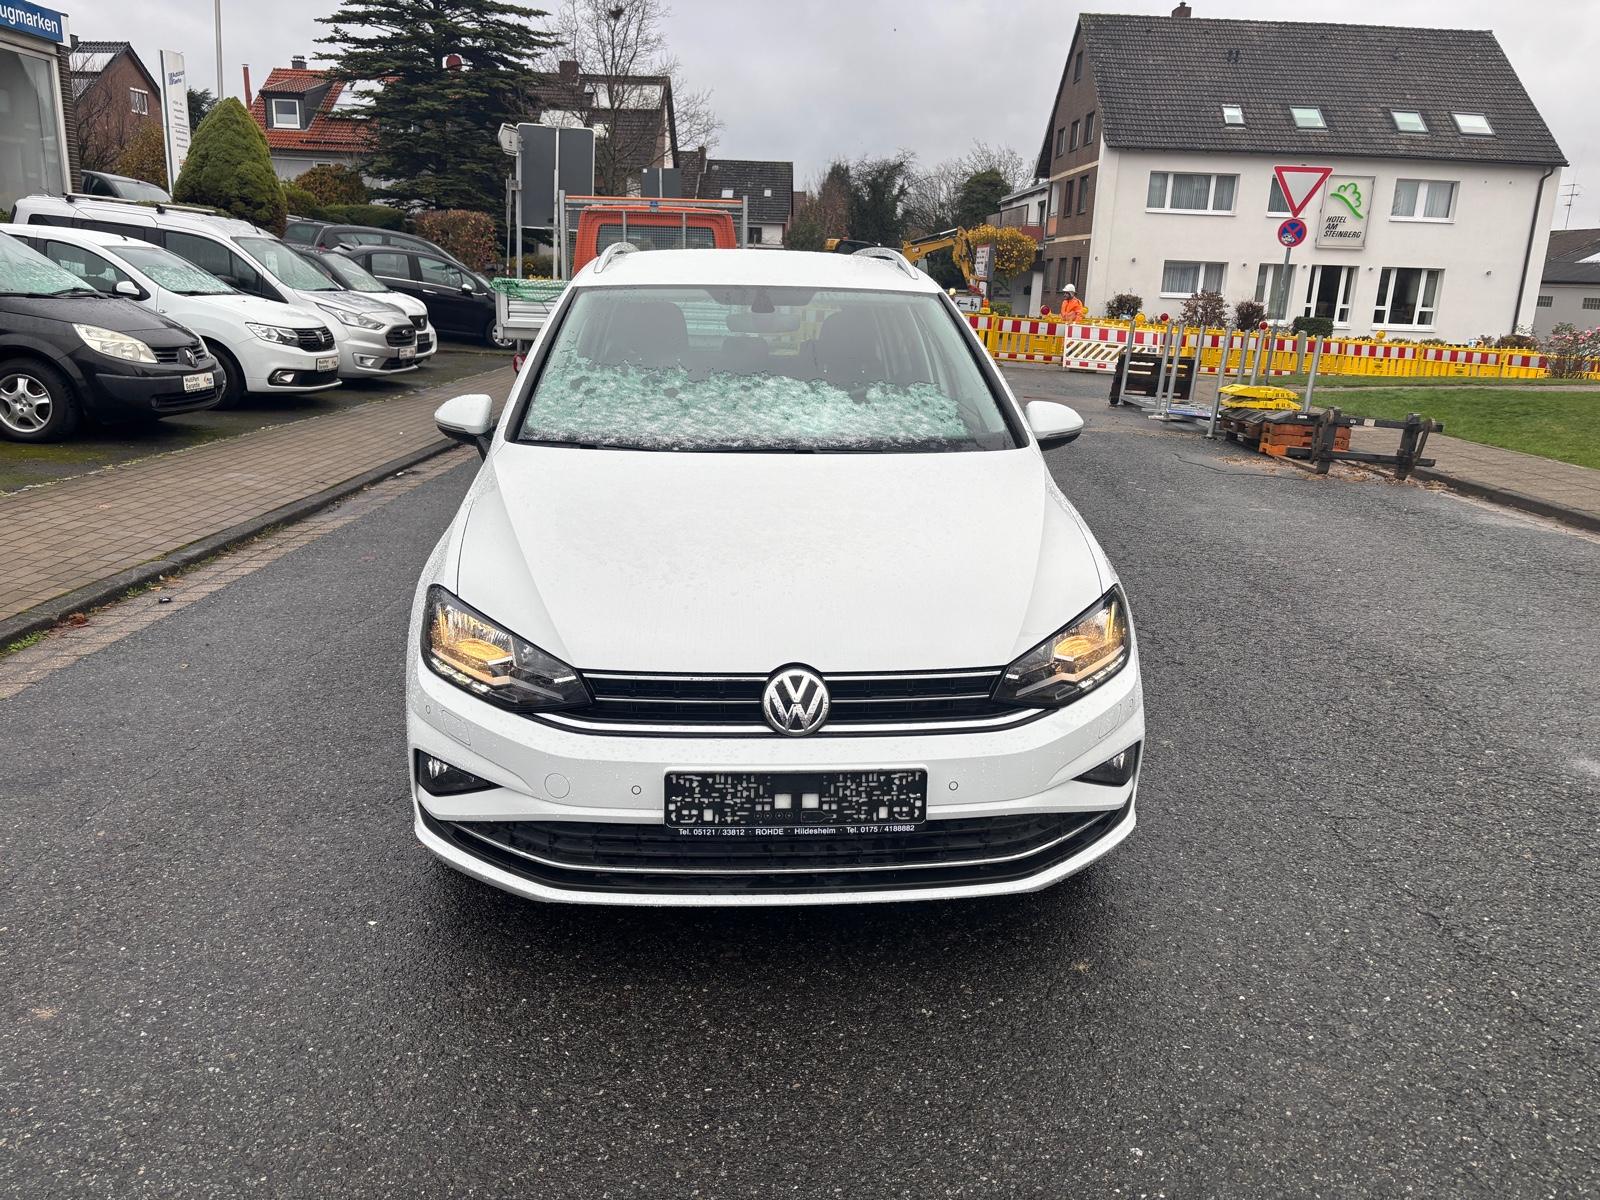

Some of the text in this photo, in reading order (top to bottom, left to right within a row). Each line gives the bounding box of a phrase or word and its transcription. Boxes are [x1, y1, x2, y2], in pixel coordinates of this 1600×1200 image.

[0, 4, 59, 34] ugmarken
[1326, 216, 1347, 224] HOTEL
[1323, 230, 1362, 239] STEINBERG
[678, 828, 691, 836] Tel.
[693, 828, 715, 836] 05121
[722, 828, 745, 836] 33812
[794, 827, 836, 835] Hildesheim
